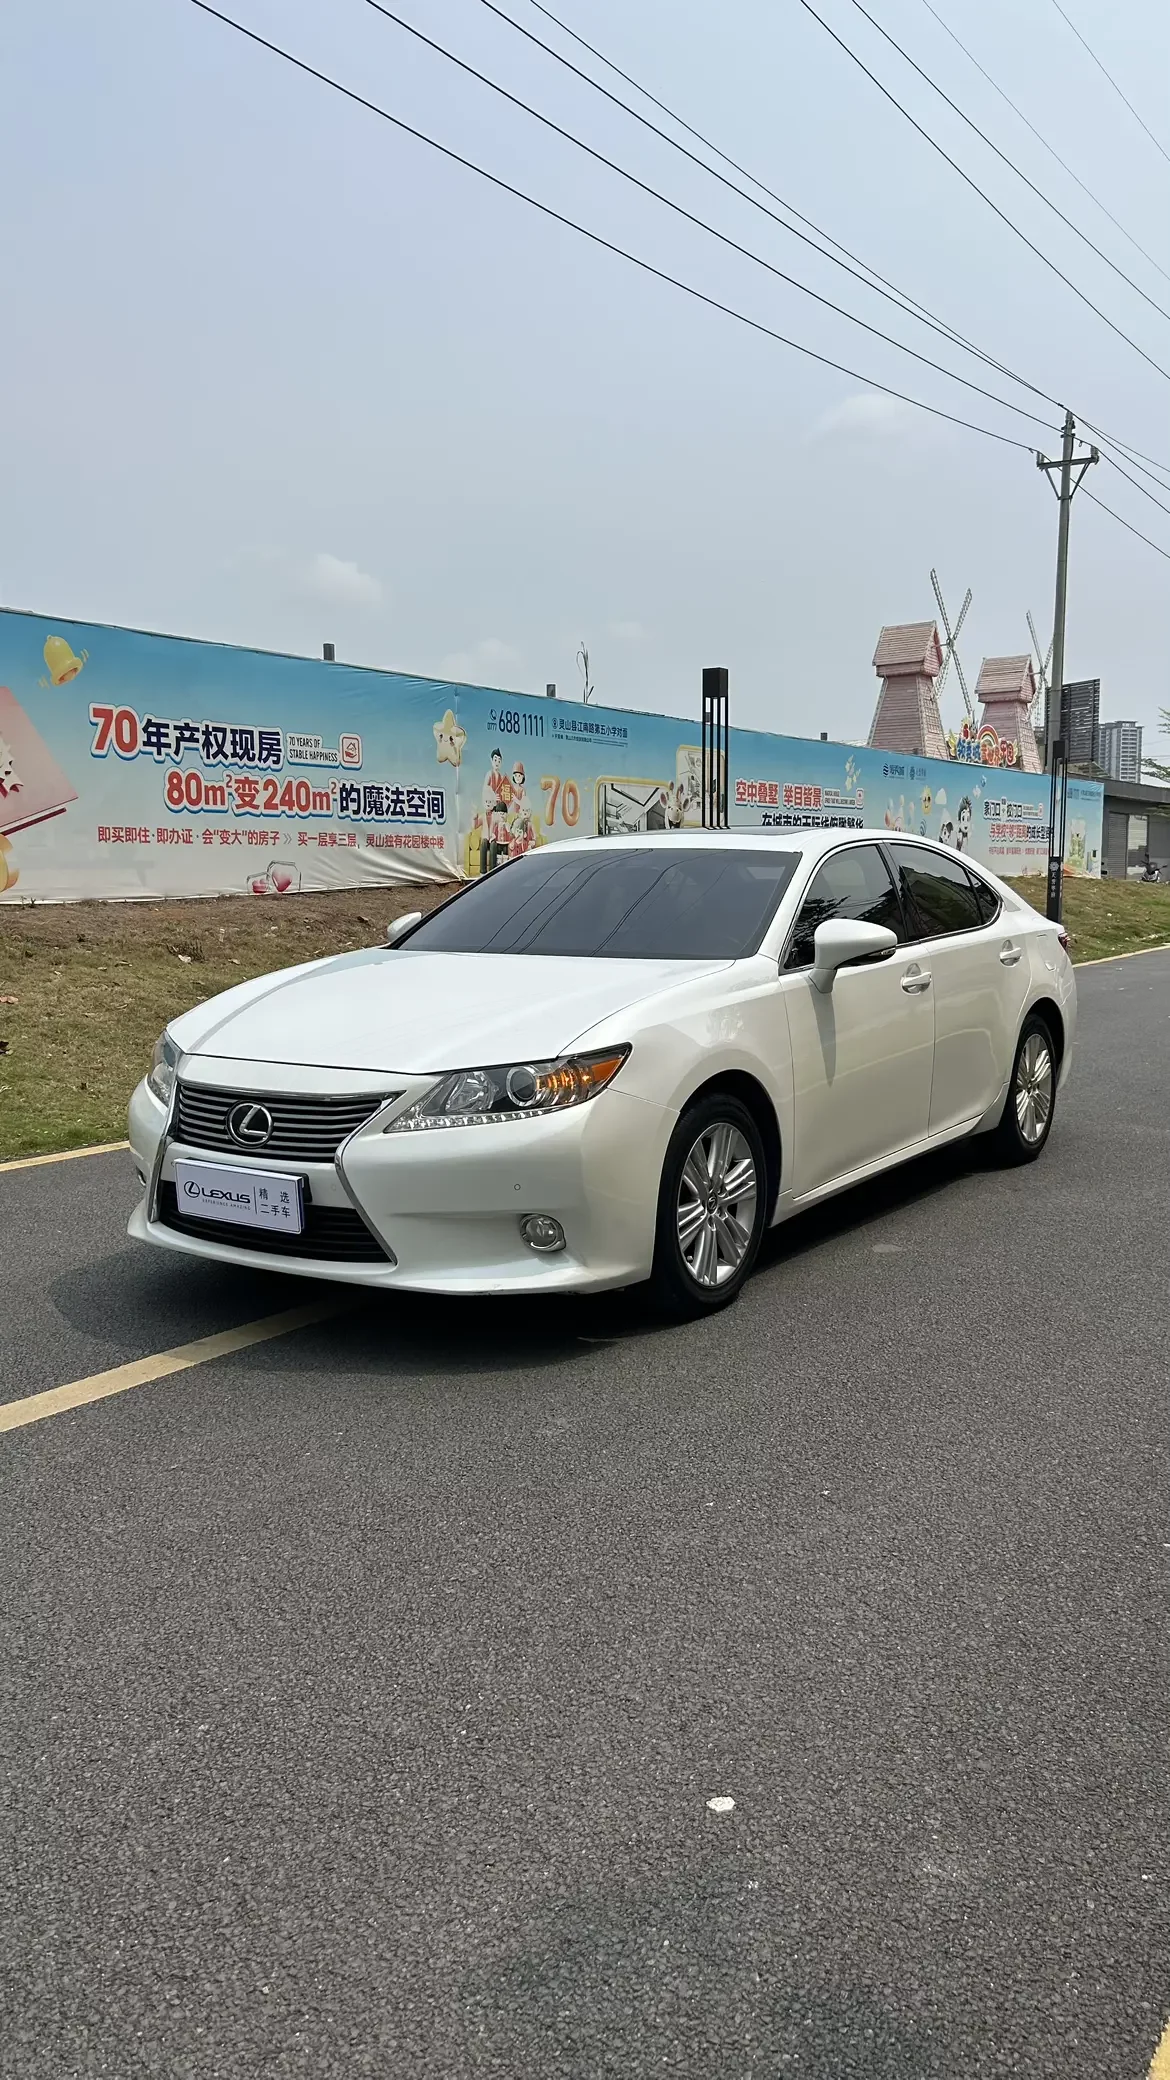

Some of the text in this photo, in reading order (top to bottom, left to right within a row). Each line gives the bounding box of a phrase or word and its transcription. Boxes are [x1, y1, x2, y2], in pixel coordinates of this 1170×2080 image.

[92, 707, 282, 765] 70年产权现房
[288, 736, 321, 748] 70 YEARS OF
[288, 749, 338, 763] STABLE HAPPINESS
[540, 775, 580, 827] 70
[736, 780, 822, 808] 空中叠墅 举目皆景
[201, 1187, 250, 1204] LEXUS
[258, 1188, 291, 1204] 精选
[260, 1203, 291, 1218] 二手车
